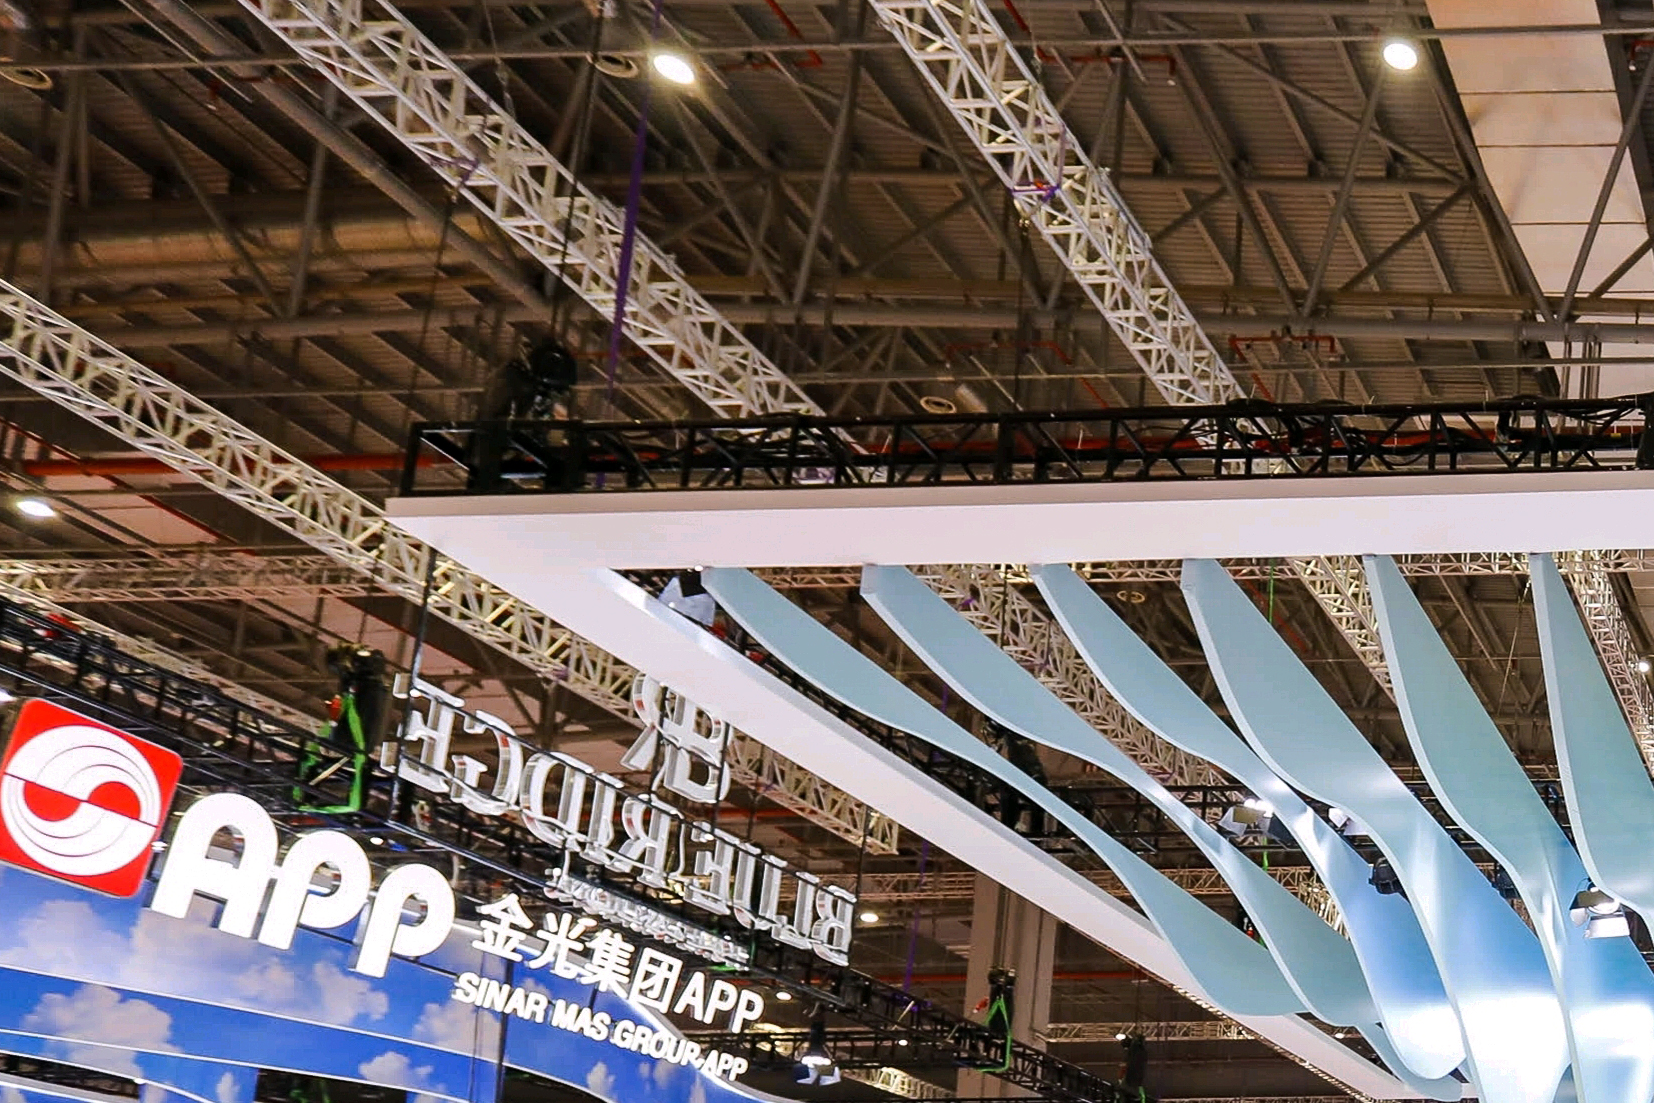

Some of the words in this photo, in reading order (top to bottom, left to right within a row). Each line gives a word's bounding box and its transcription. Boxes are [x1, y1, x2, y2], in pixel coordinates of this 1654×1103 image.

[151, 792, 456, 979] APP
[452, 971, 549, 1023] SINAR
[550, 999, 613, 1042] MAS
[611, 1019, 704, 1069] GROUP
[699, 1049, 749, 1082] APP
[472, 893, 764, 1034] 金光集团APP
